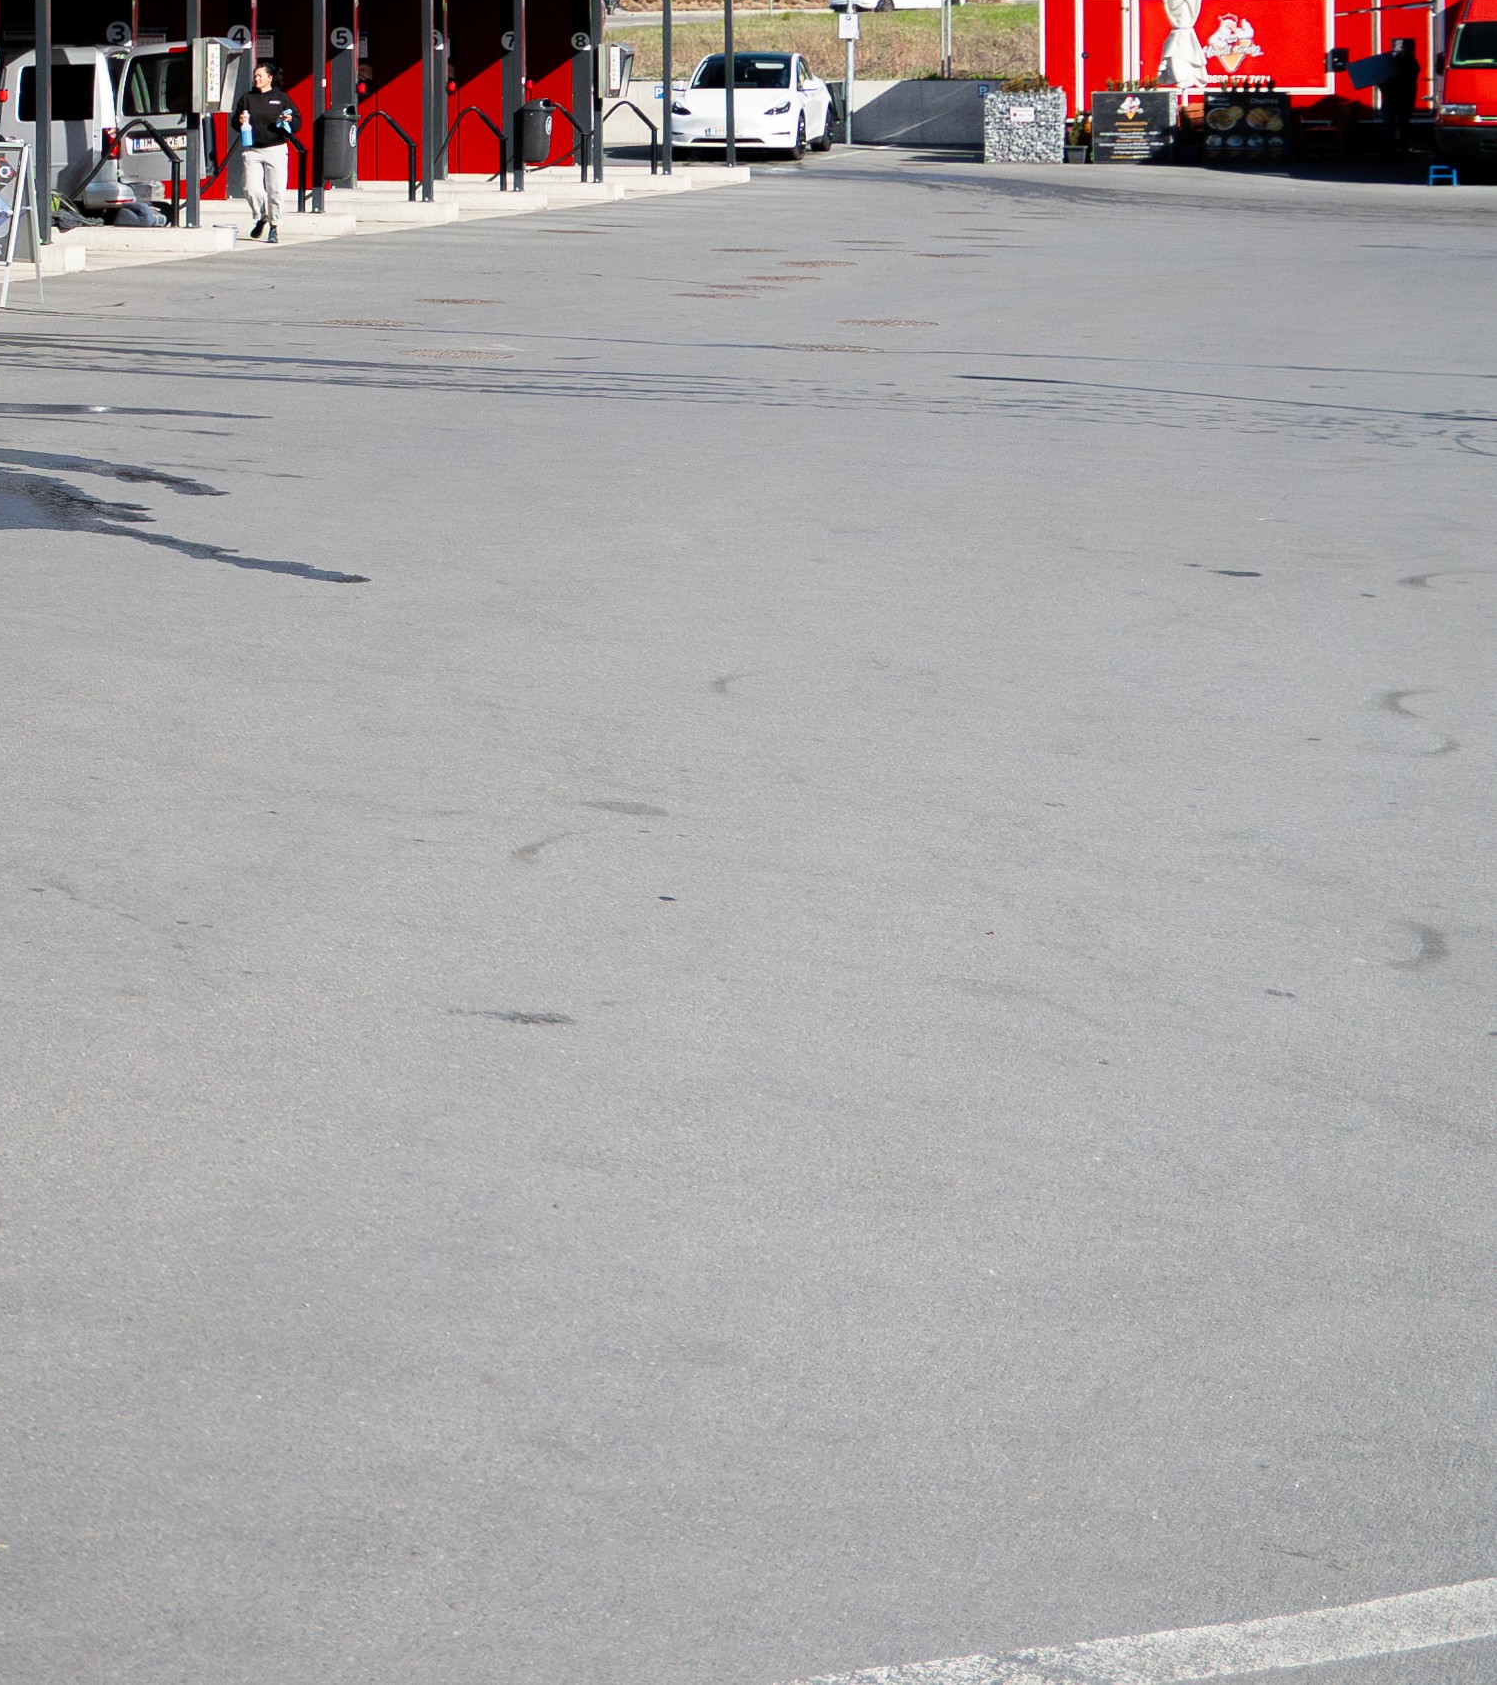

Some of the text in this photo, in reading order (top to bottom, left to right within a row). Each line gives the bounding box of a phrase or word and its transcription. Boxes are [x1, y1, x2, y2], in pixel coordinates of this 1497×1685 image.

[112, 24, 126, 43] 3
[232, 28, 246, 44] 4
[336, 30, 348, 46] 5
[575, 35, 586, 47] 8
